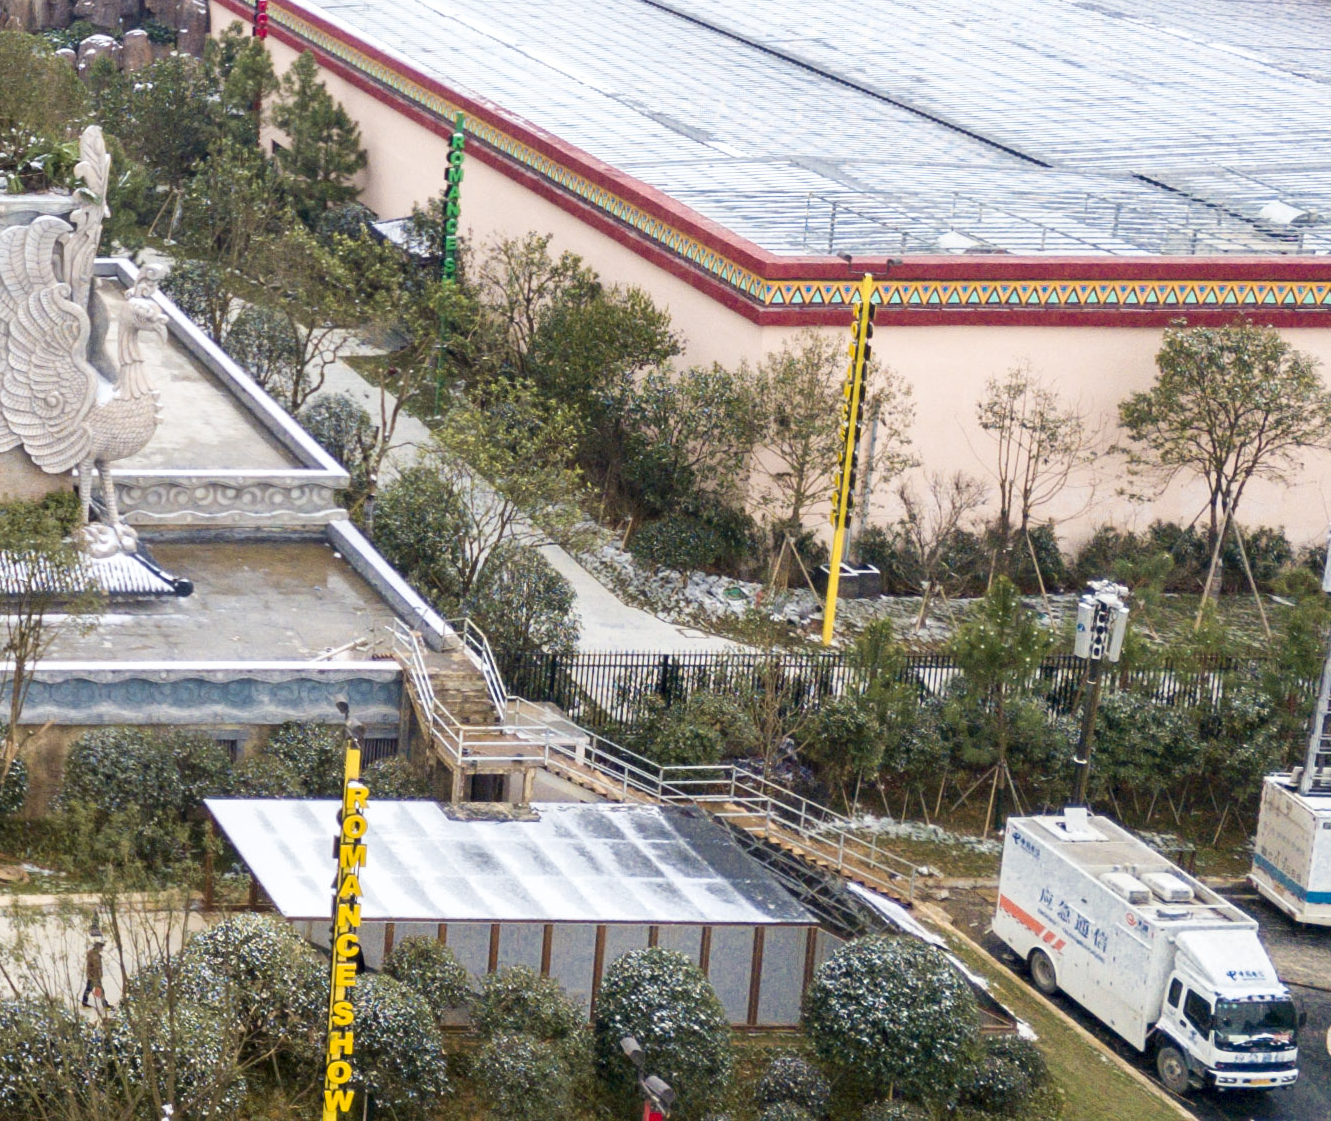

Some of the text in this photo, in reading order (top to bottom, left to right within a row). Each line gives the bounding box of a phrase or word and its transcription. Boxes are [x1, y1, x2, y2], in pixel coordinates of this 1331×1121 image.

[445, 132, 465, 252] ROMANCE
[323, 781, 370, 1113] ROMANCE SHOW
[1039, 887, 1108, 954] 应急通信
